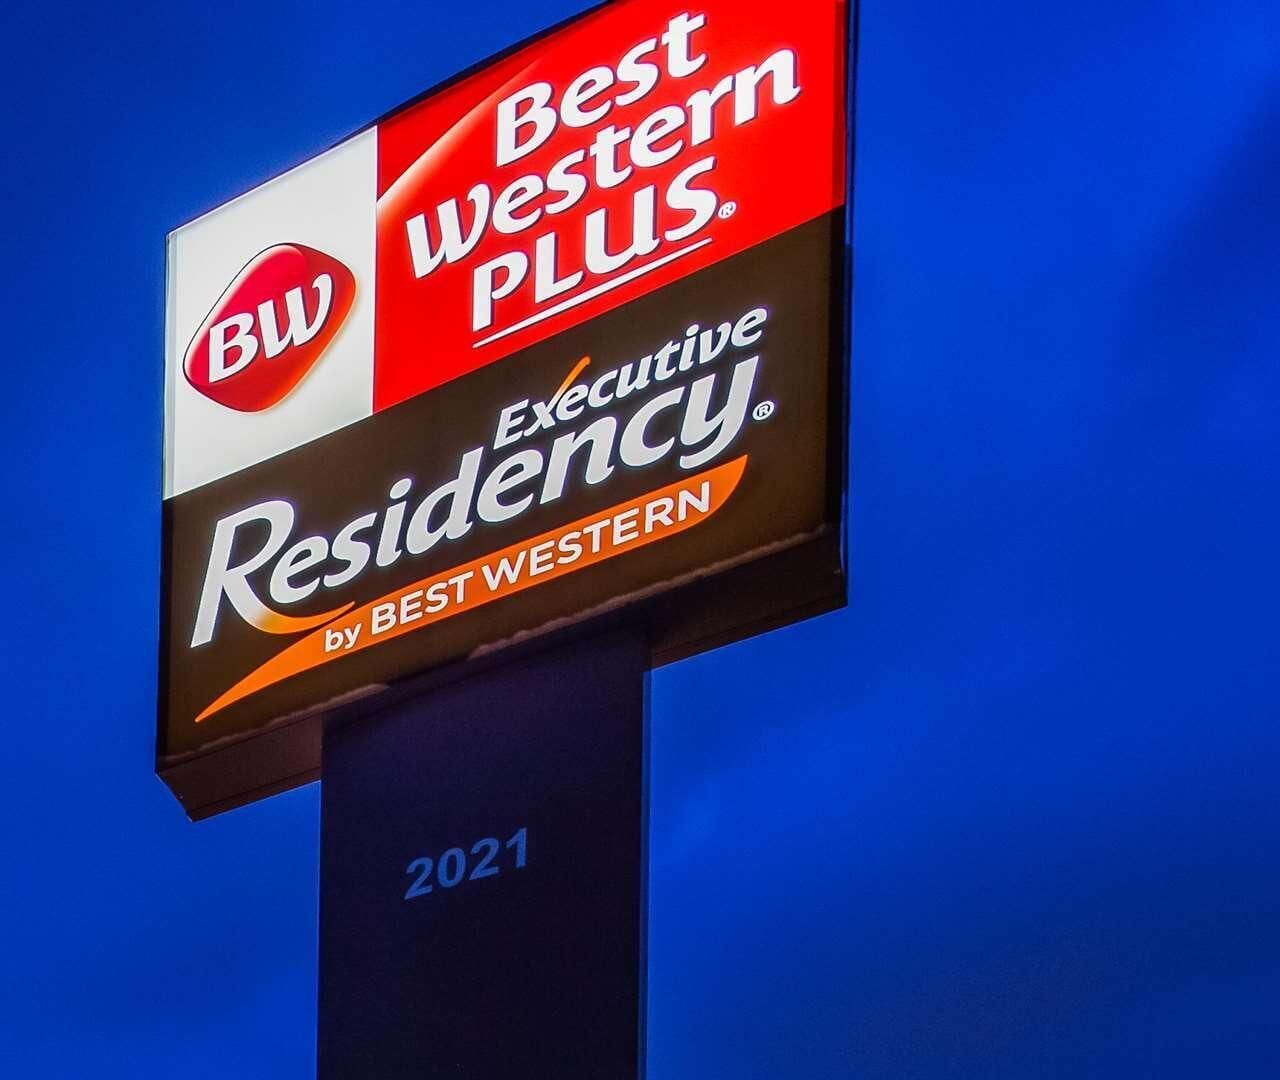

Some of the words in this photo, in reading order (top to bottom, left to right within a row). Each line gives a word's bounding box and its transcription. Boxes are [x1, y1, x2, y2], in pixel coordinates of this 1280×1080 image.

[406, 48, 801, 280] Western
[496, 12, 708, 168] Best
[207, 273, 332, 384] BW
[493, 308, 767, 450] Executive
[190, 356, 759, 649] Residency
[324, 619, 363, 653] by
[370, 572, 474, 636] BEST
[481, 480, 712, 592] WESTERN
[404, 827, 527, 900] 2021
